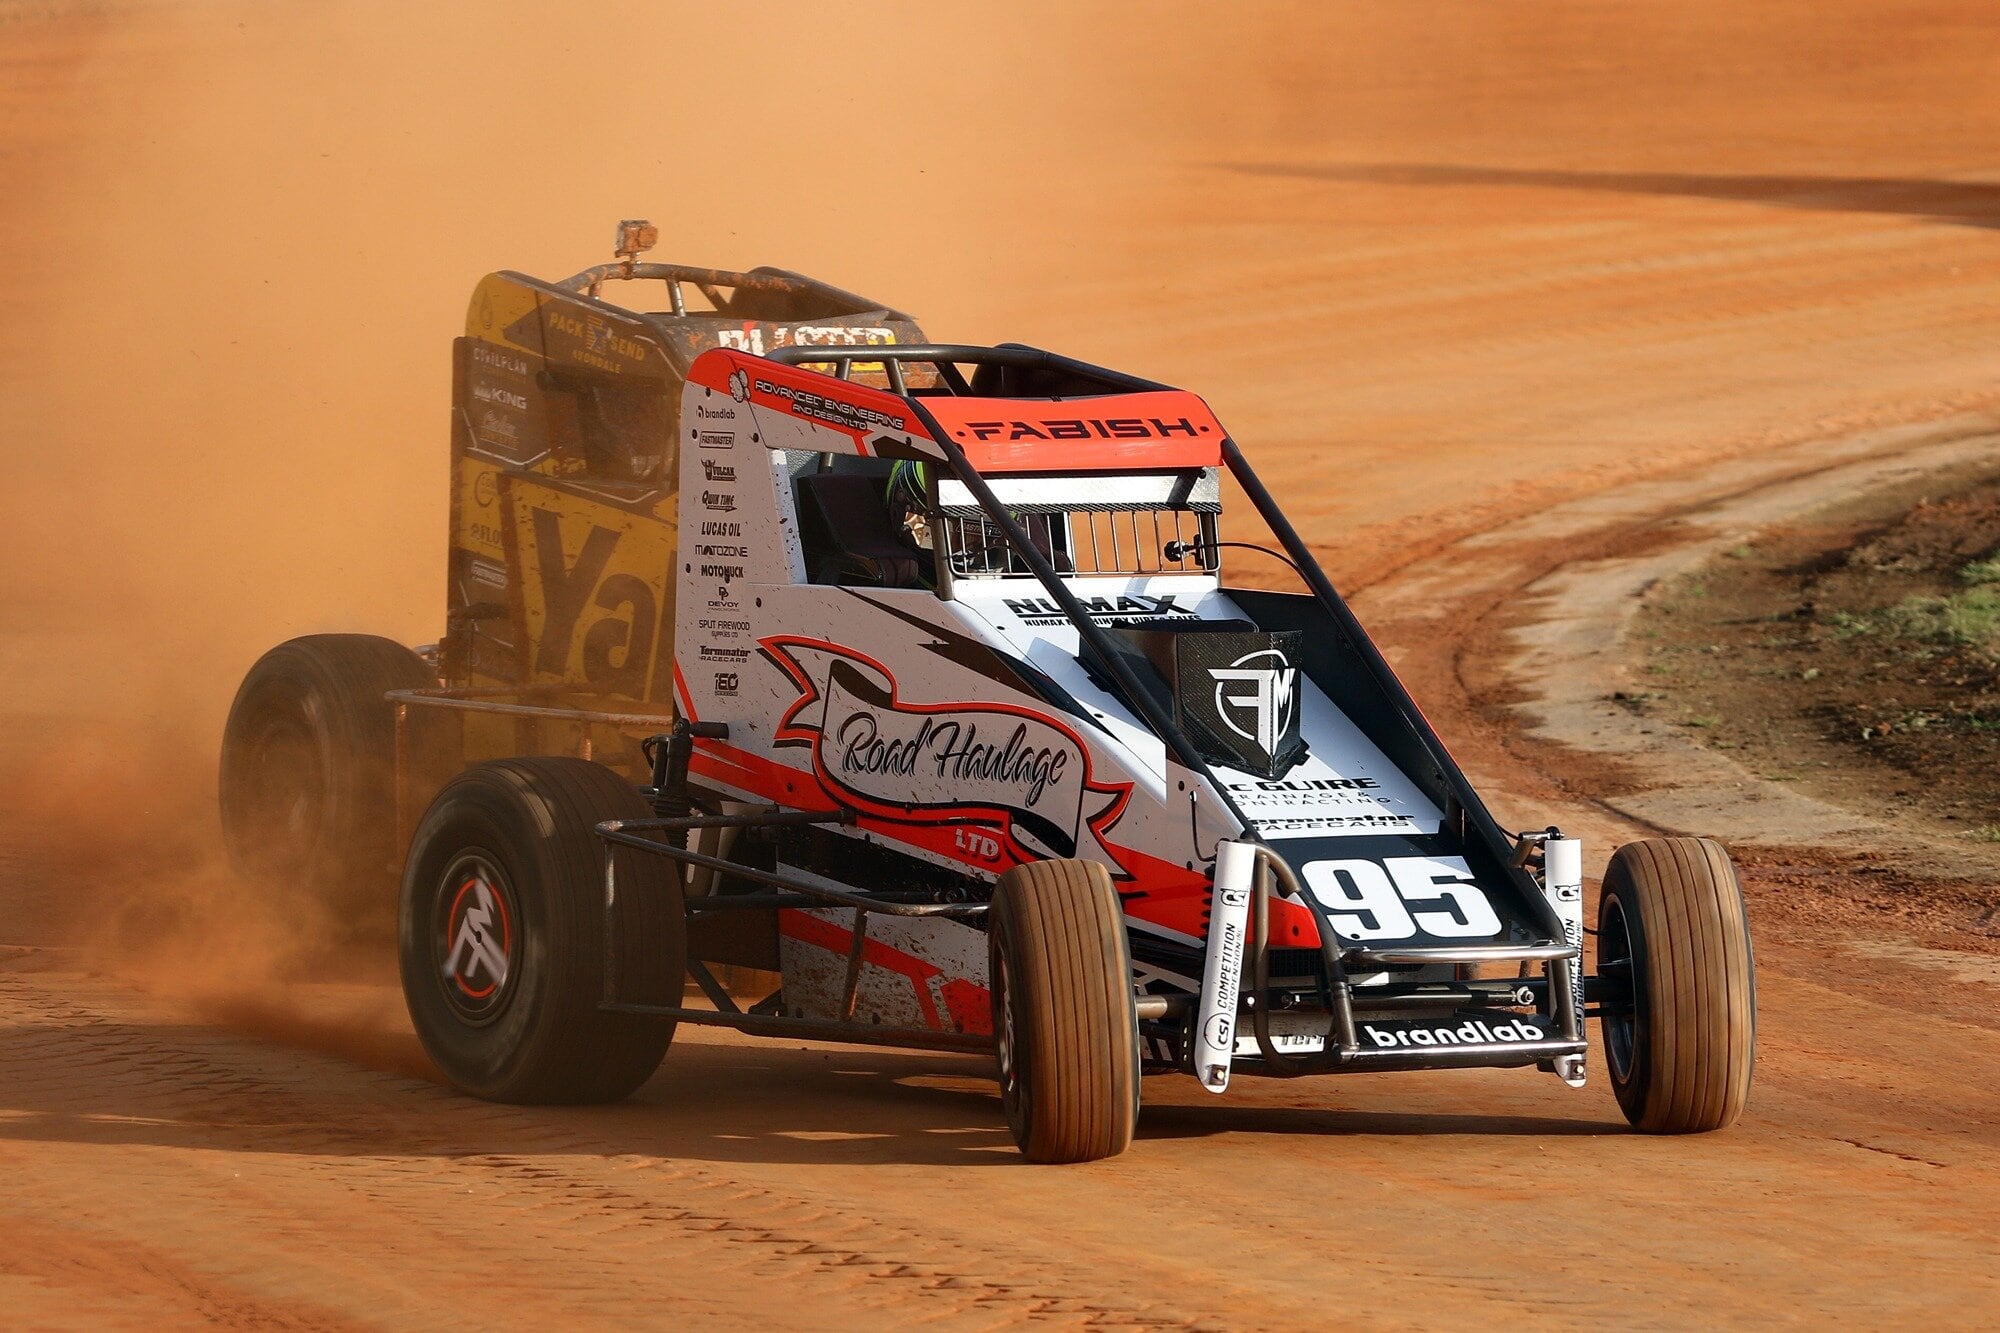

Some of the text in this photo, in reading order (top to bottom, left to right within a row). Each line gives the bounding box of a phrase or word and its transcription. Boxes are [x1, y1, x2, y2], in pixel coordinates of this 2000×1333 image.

[705, 408, 736, 419] brandlab
[792, 403, 868, 430] AND DESIGN LTD
[824, 400, 903, 429] ENGINEERING
[964, 417, 1200, 441] FABISH
[702, 435, 733, 445] FASTMASTER
[701, 521, 741, 537] LUCAS OIL
[708, 600, 740, 608] DEVOY
[717, 620, 750, 631] FIREWOOD
[1024, 618, 1066, 627] NUMAX
[699, 645, 751, 657] Terminator
[699, 655, 747, 664] RACECARS
[839, 711, 1068, 808] Road Haulage
[1230, 791, 1349, 800] RAINAGE
[1234, 797, 1391, 807] ONTRACTING
[1247, 815, 1415, 826] erminator
[954, 828, 999, 860] LTD
[1301, 855, 1502, 941] 95
[1217, 922, 1236, 1010] COMPETITION
[1228, 942, 1242, 1013] SUSPENSION
[1217, 1018, 1230, 1046] CSI
[1364, 1018, 1544, 1048] brandlab
